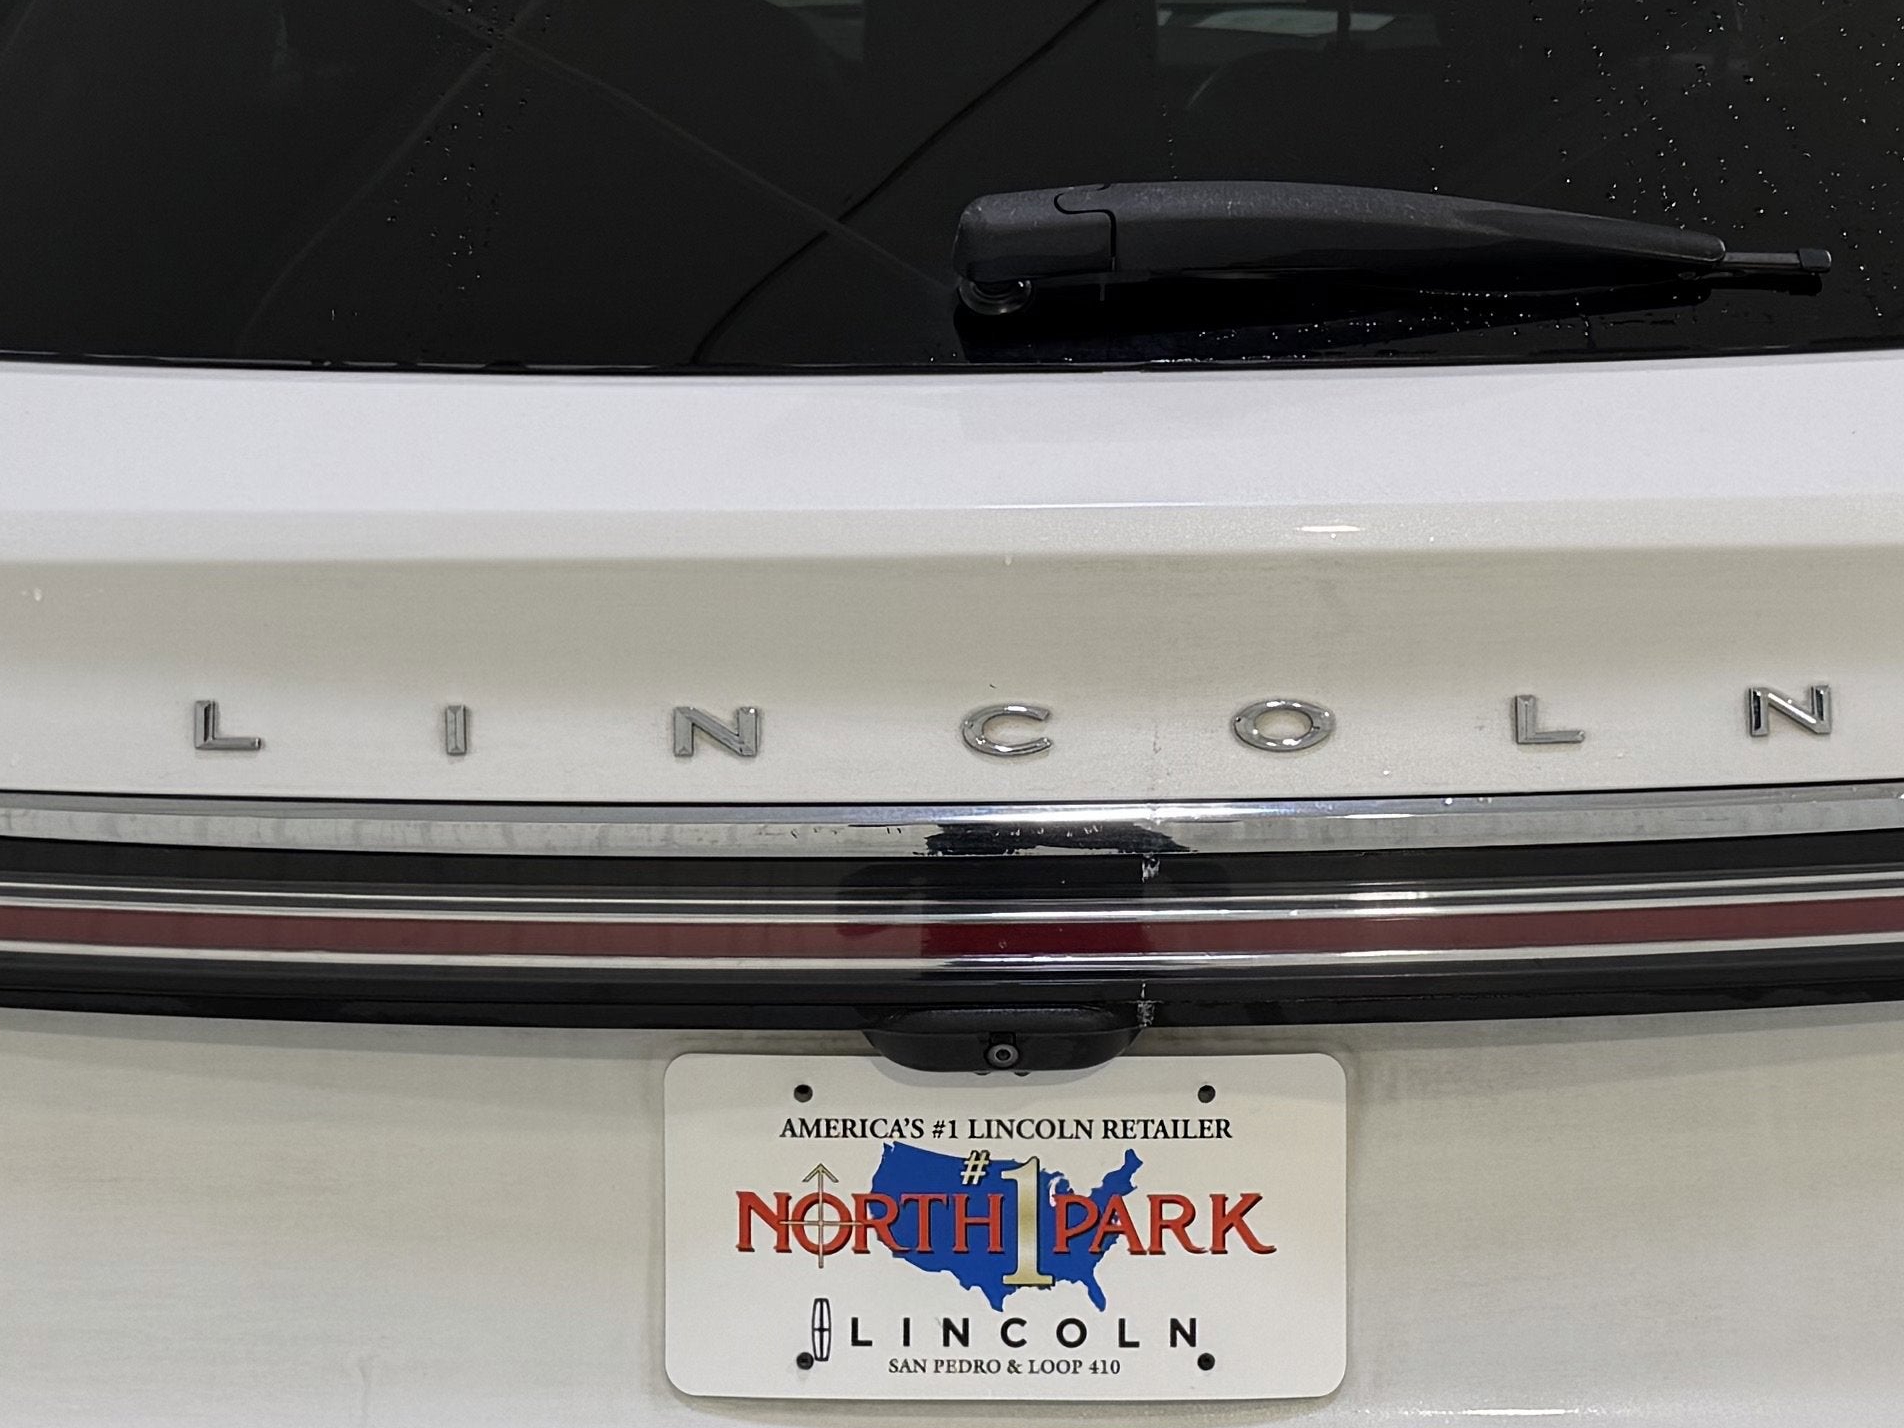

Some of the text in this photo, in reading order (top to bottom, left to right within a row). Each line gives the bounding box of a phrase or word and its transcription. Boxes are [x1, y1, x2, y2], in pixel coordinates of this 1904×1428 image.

[194, 684, 1832, 759] LINCOLN
[779, 1117, 1233, 1140] AMERICA'S #1 LINCOLN RETAILER
[736, 1190, 1278, 1256] NORTH PARK
[851, 1316, 1198, 1349] LINCOLN
[888, 1358, 1121, 1375] SAN PEDRO & LOOP 410
